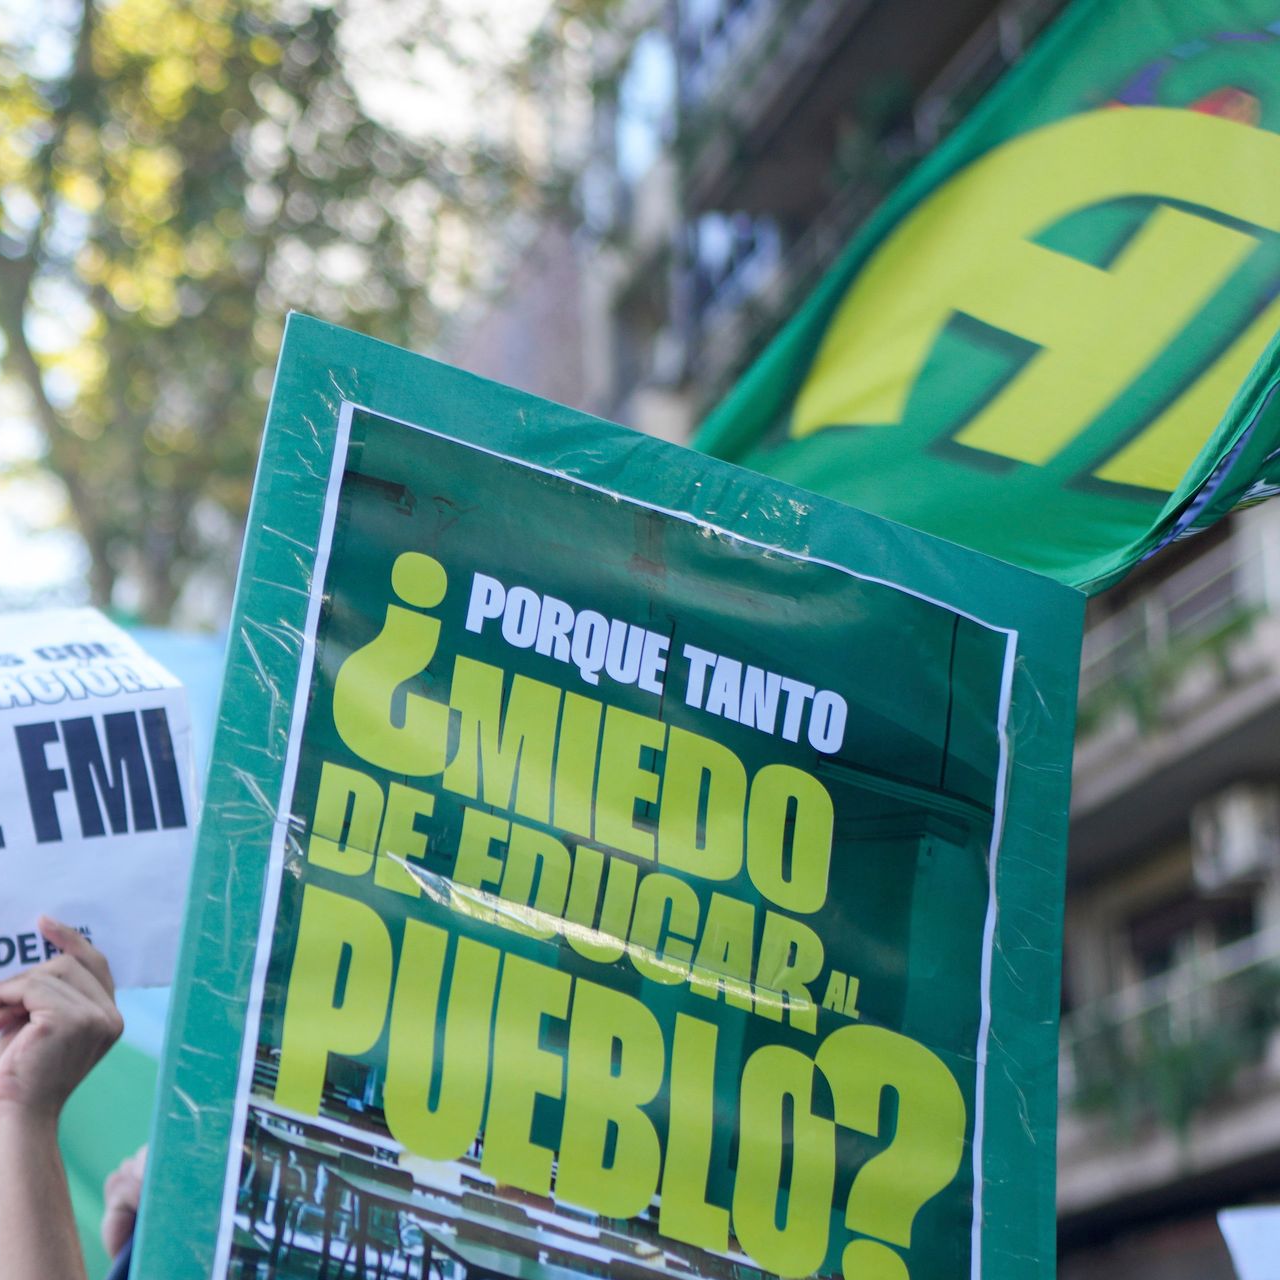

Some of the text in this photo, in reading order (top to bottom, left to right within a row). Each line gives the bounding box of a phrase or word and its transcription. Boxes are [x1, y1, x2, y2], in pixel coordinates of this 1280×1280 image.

[13, 706, 188, 844] FMI
[333, 551, 835, 915] ¿MIEDO
[465, 571, 848, 755] PORQUE TANTO
[306, 761, 860, 1036] DE EDUCAR AL
